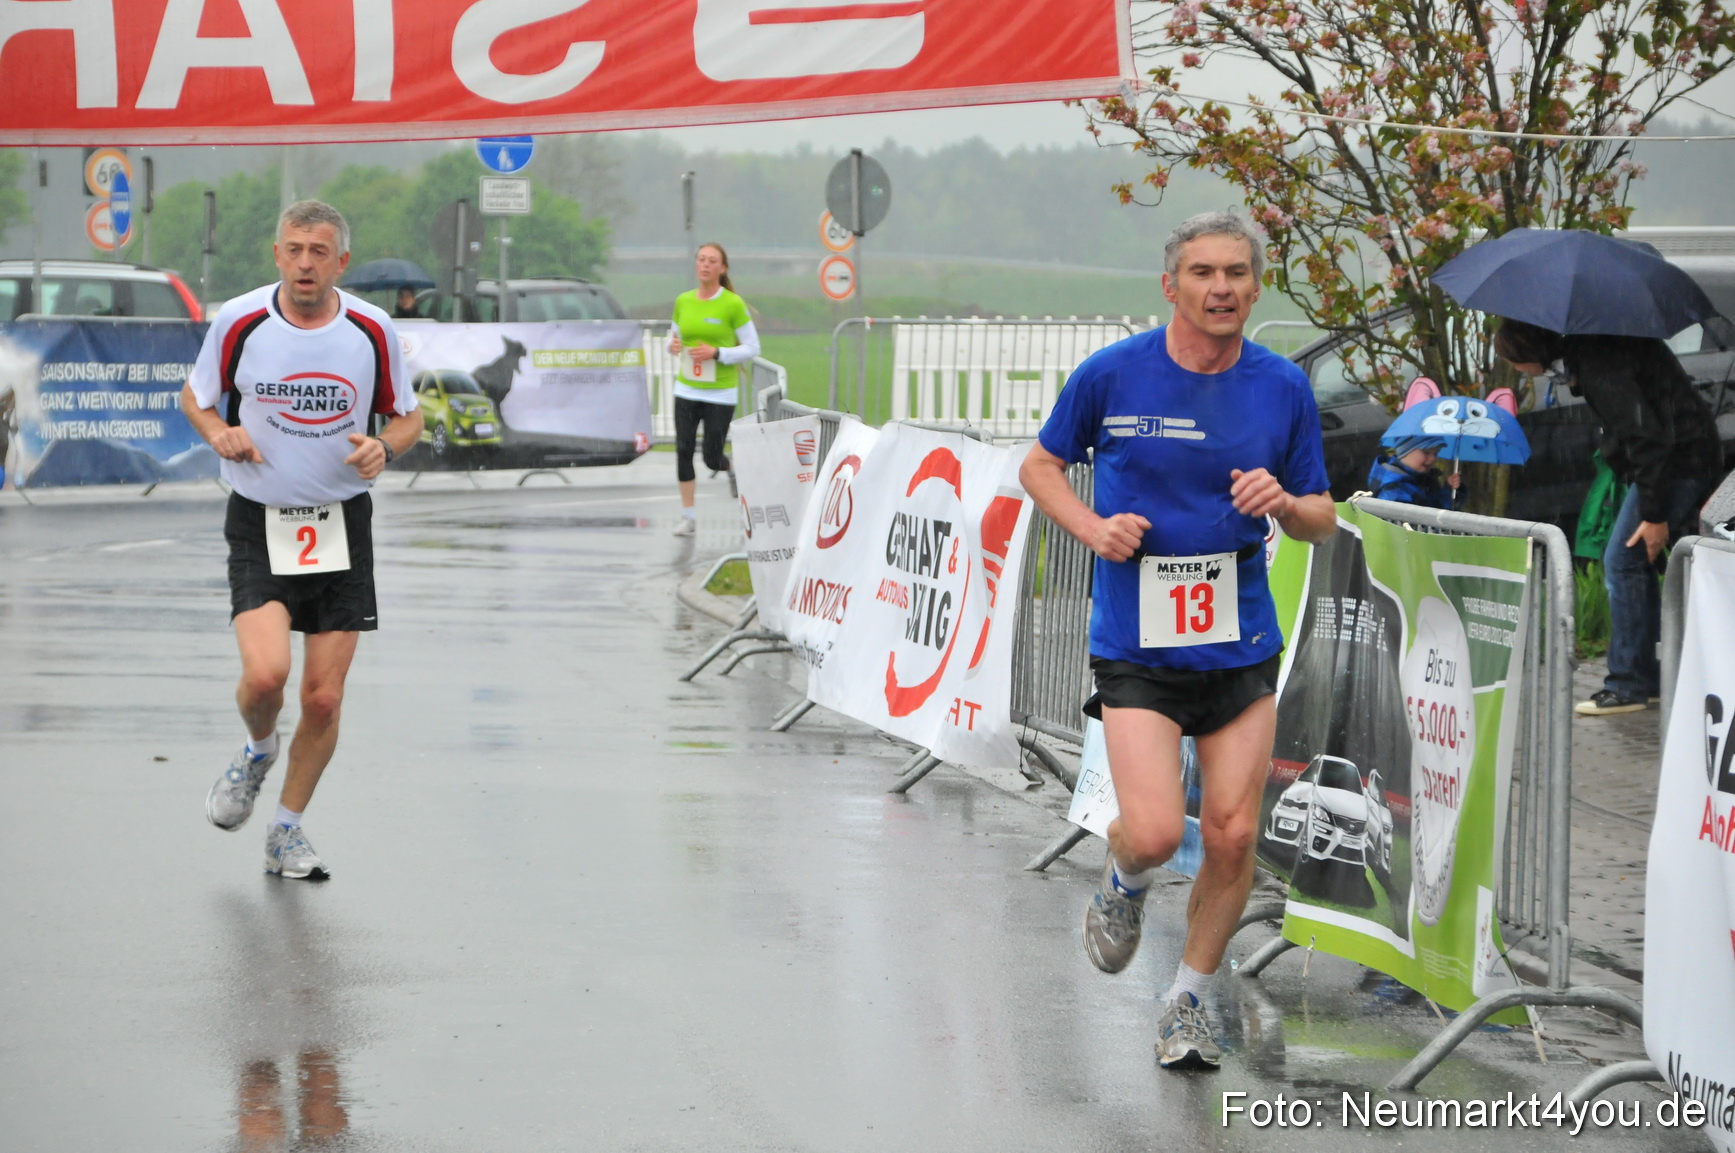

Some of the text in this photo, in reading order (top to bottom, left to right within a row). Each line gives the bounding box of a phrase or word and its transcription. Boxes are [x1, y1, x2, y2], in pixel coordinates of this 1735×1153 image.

[41, 362, 125, 381] SAISONSTART
[128, 363, 148, 382] BEI
[255, 383, 339, 397] GERHART
[40, 391, 74, 409] GANZ
[77, 391, 108, 409] WEIT
[109, 391, 143, 409] VORN
[147, 391, 169, 410] MIT
[256, 397, 292, 405] Autohaus
[40, 420, 162, 439] WINTERANGEBOTEN
[266, 415, 355, 438] Das sportliche Autohaus
[279, 507, 316, 523] MEYER WERBUNG
[296, 525, 319, 566] 2
[886, 511, 959, 579] GRHAT &
[1157, 562, 1204, 581] MEYER WERBUNG
[1169, 582, 1214, 634] 13
[1425, 648, 1457, 688] Bis zu
[1422, 765, 1461, 811] paren!
